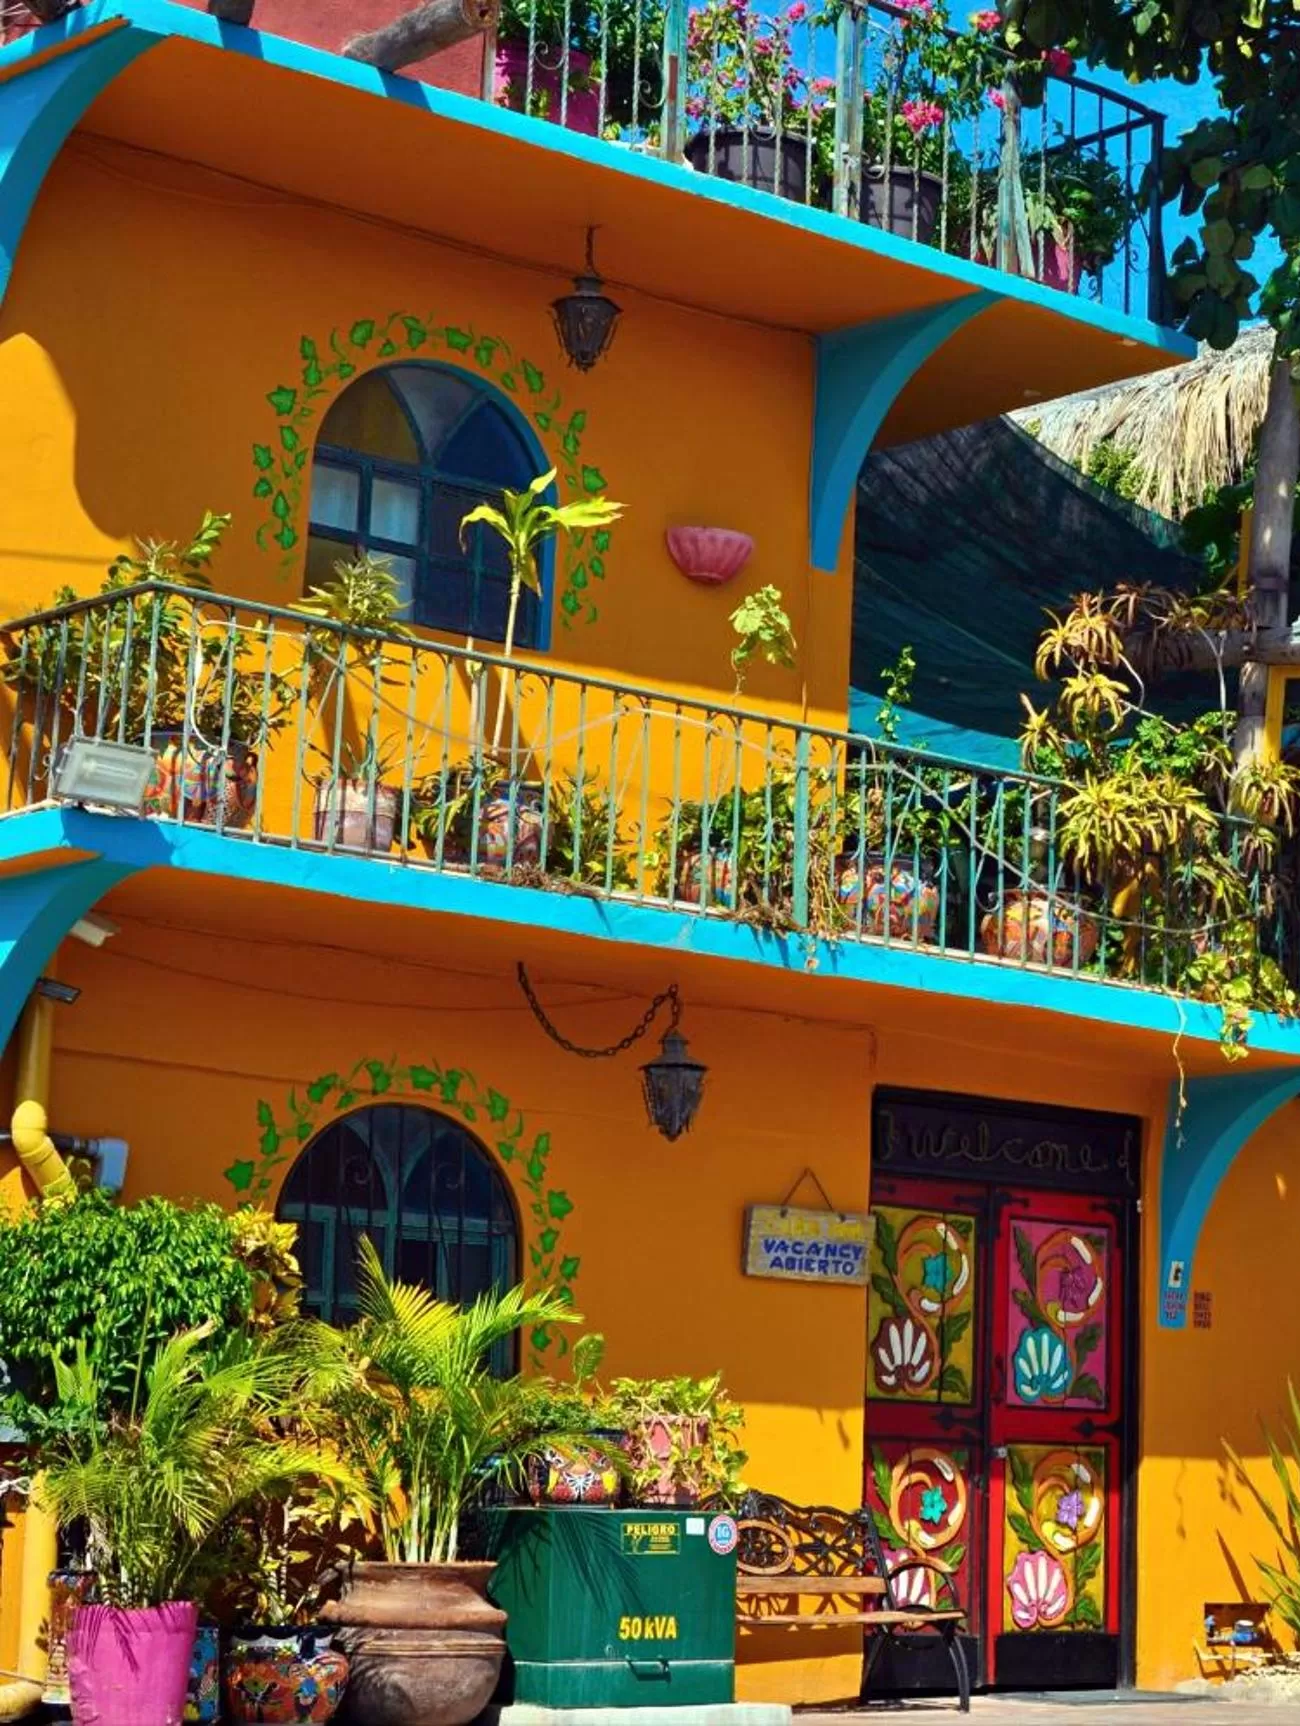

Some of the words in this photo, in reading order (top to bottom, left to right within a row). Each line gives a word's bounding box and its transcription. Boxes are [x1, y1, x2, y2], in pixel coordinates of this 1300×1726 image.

[763, 1237, 866, 1261] VACANCY
[769, 1256, 855, 1276] ABIERTO
[626, 1524, 676, 1536] PELIGRO
